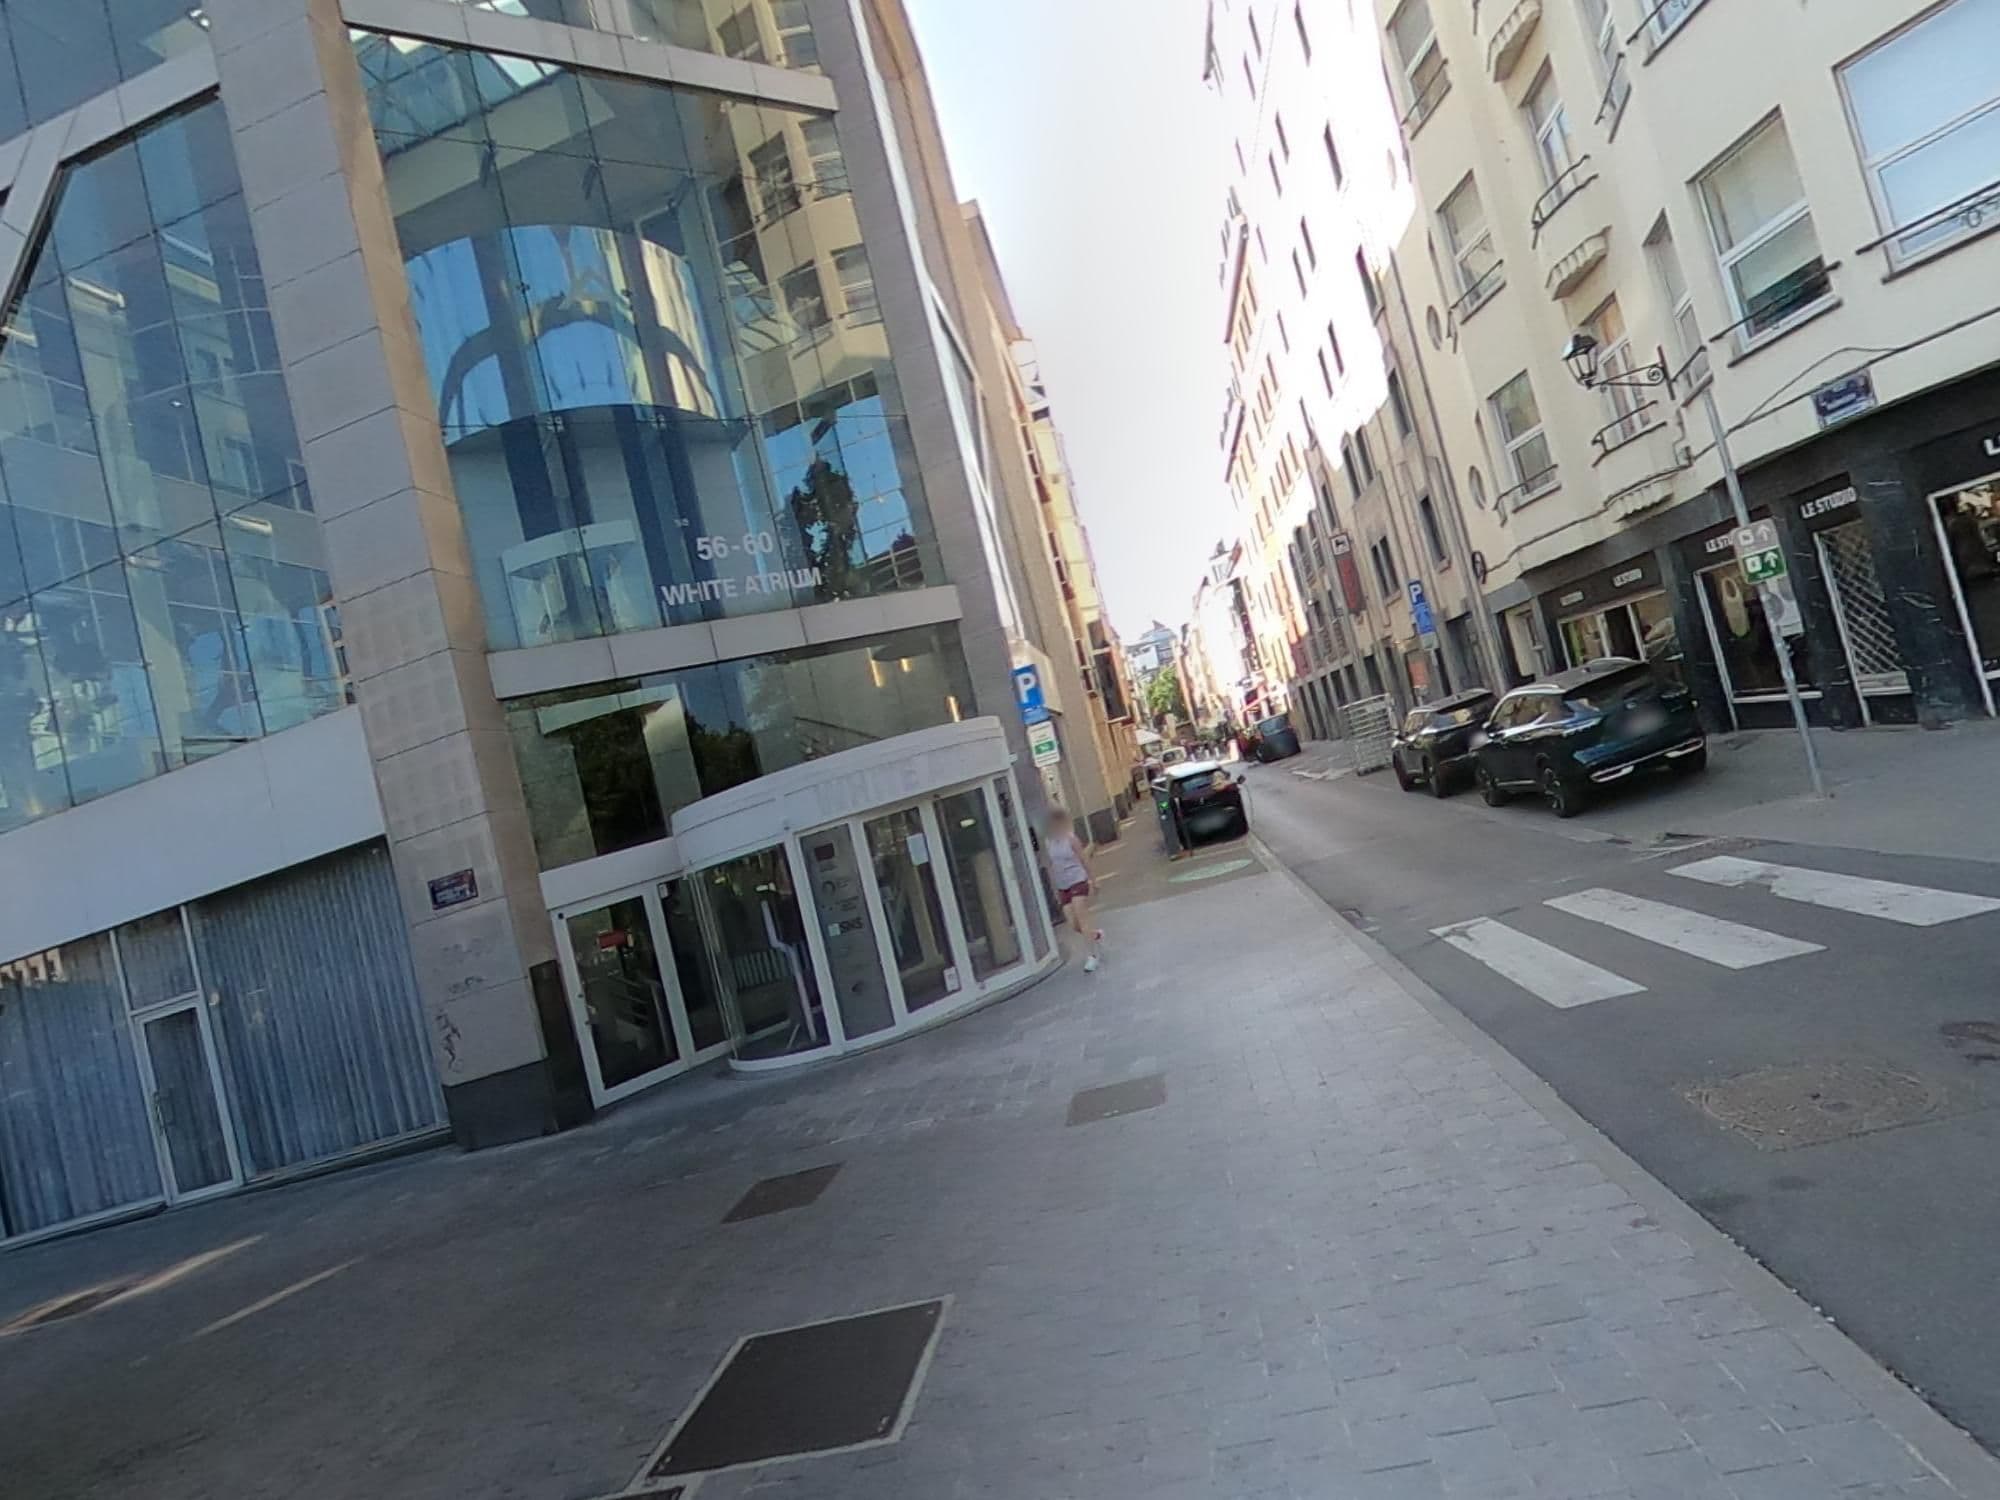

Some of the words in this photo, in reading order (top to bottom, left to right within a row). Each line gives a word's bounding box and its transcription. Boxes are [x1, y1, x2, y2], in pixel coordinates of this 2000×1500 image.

[696, 531, 774, 561] 56-60
[661, 577, 738, 606] WHITE
[744, 567, 822, 597] ATRIUM
[1016, 672, 1036, 705] P
